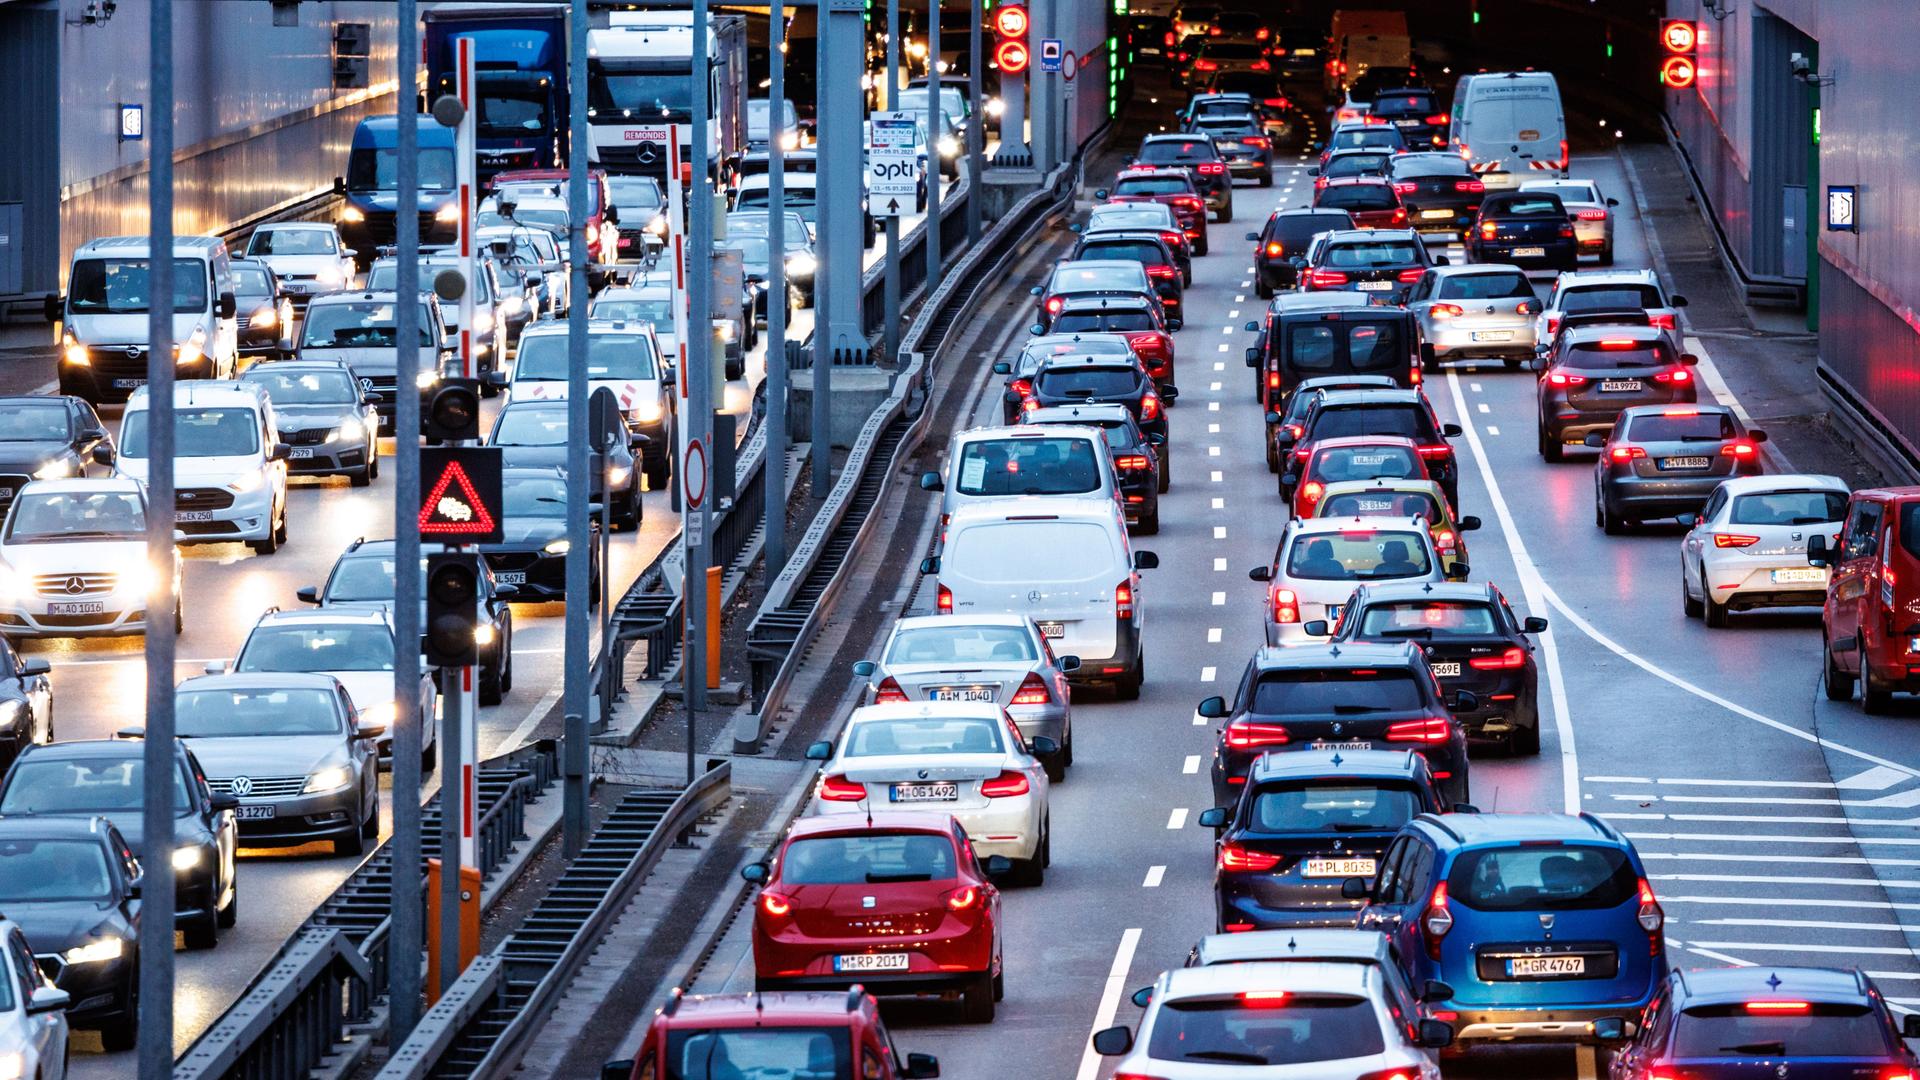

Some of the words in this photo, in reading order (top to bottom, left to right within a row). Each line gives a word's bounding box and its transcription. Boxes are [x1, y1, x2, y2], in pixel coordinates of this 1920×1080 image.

[625, 131, 666, 140] REMONDIS
[874, 160, 913, 180] opti
[1621, 382, 1638, 390] 9972
[1676, 458, 1686, 466] VA
[197, 511, 211, 520] 250
[53, 606, 60, 614] M
[80, 604, 101, 613] 1016
[952, 692, 959, 700] M
[965, 691, 989, 700] 1040
[897, 787, 905, 797] M
[929, 786, 956, 797] 1492
[247, 806, 273, 817] 1270
[1309, 862, 1317, 872] M
[1326, 861, 1340, 872] PL
[1344, 860, 1372, 872] 8035
[841, 958, 849, 968] M
[858, 957, 873, 967] RP
[877, 956, 906, 967] 2017
[1514, 962, 1523, 972] M
[1531, 960, 1547, 971] GR
[1550, 959, 1580, 971] 4767
